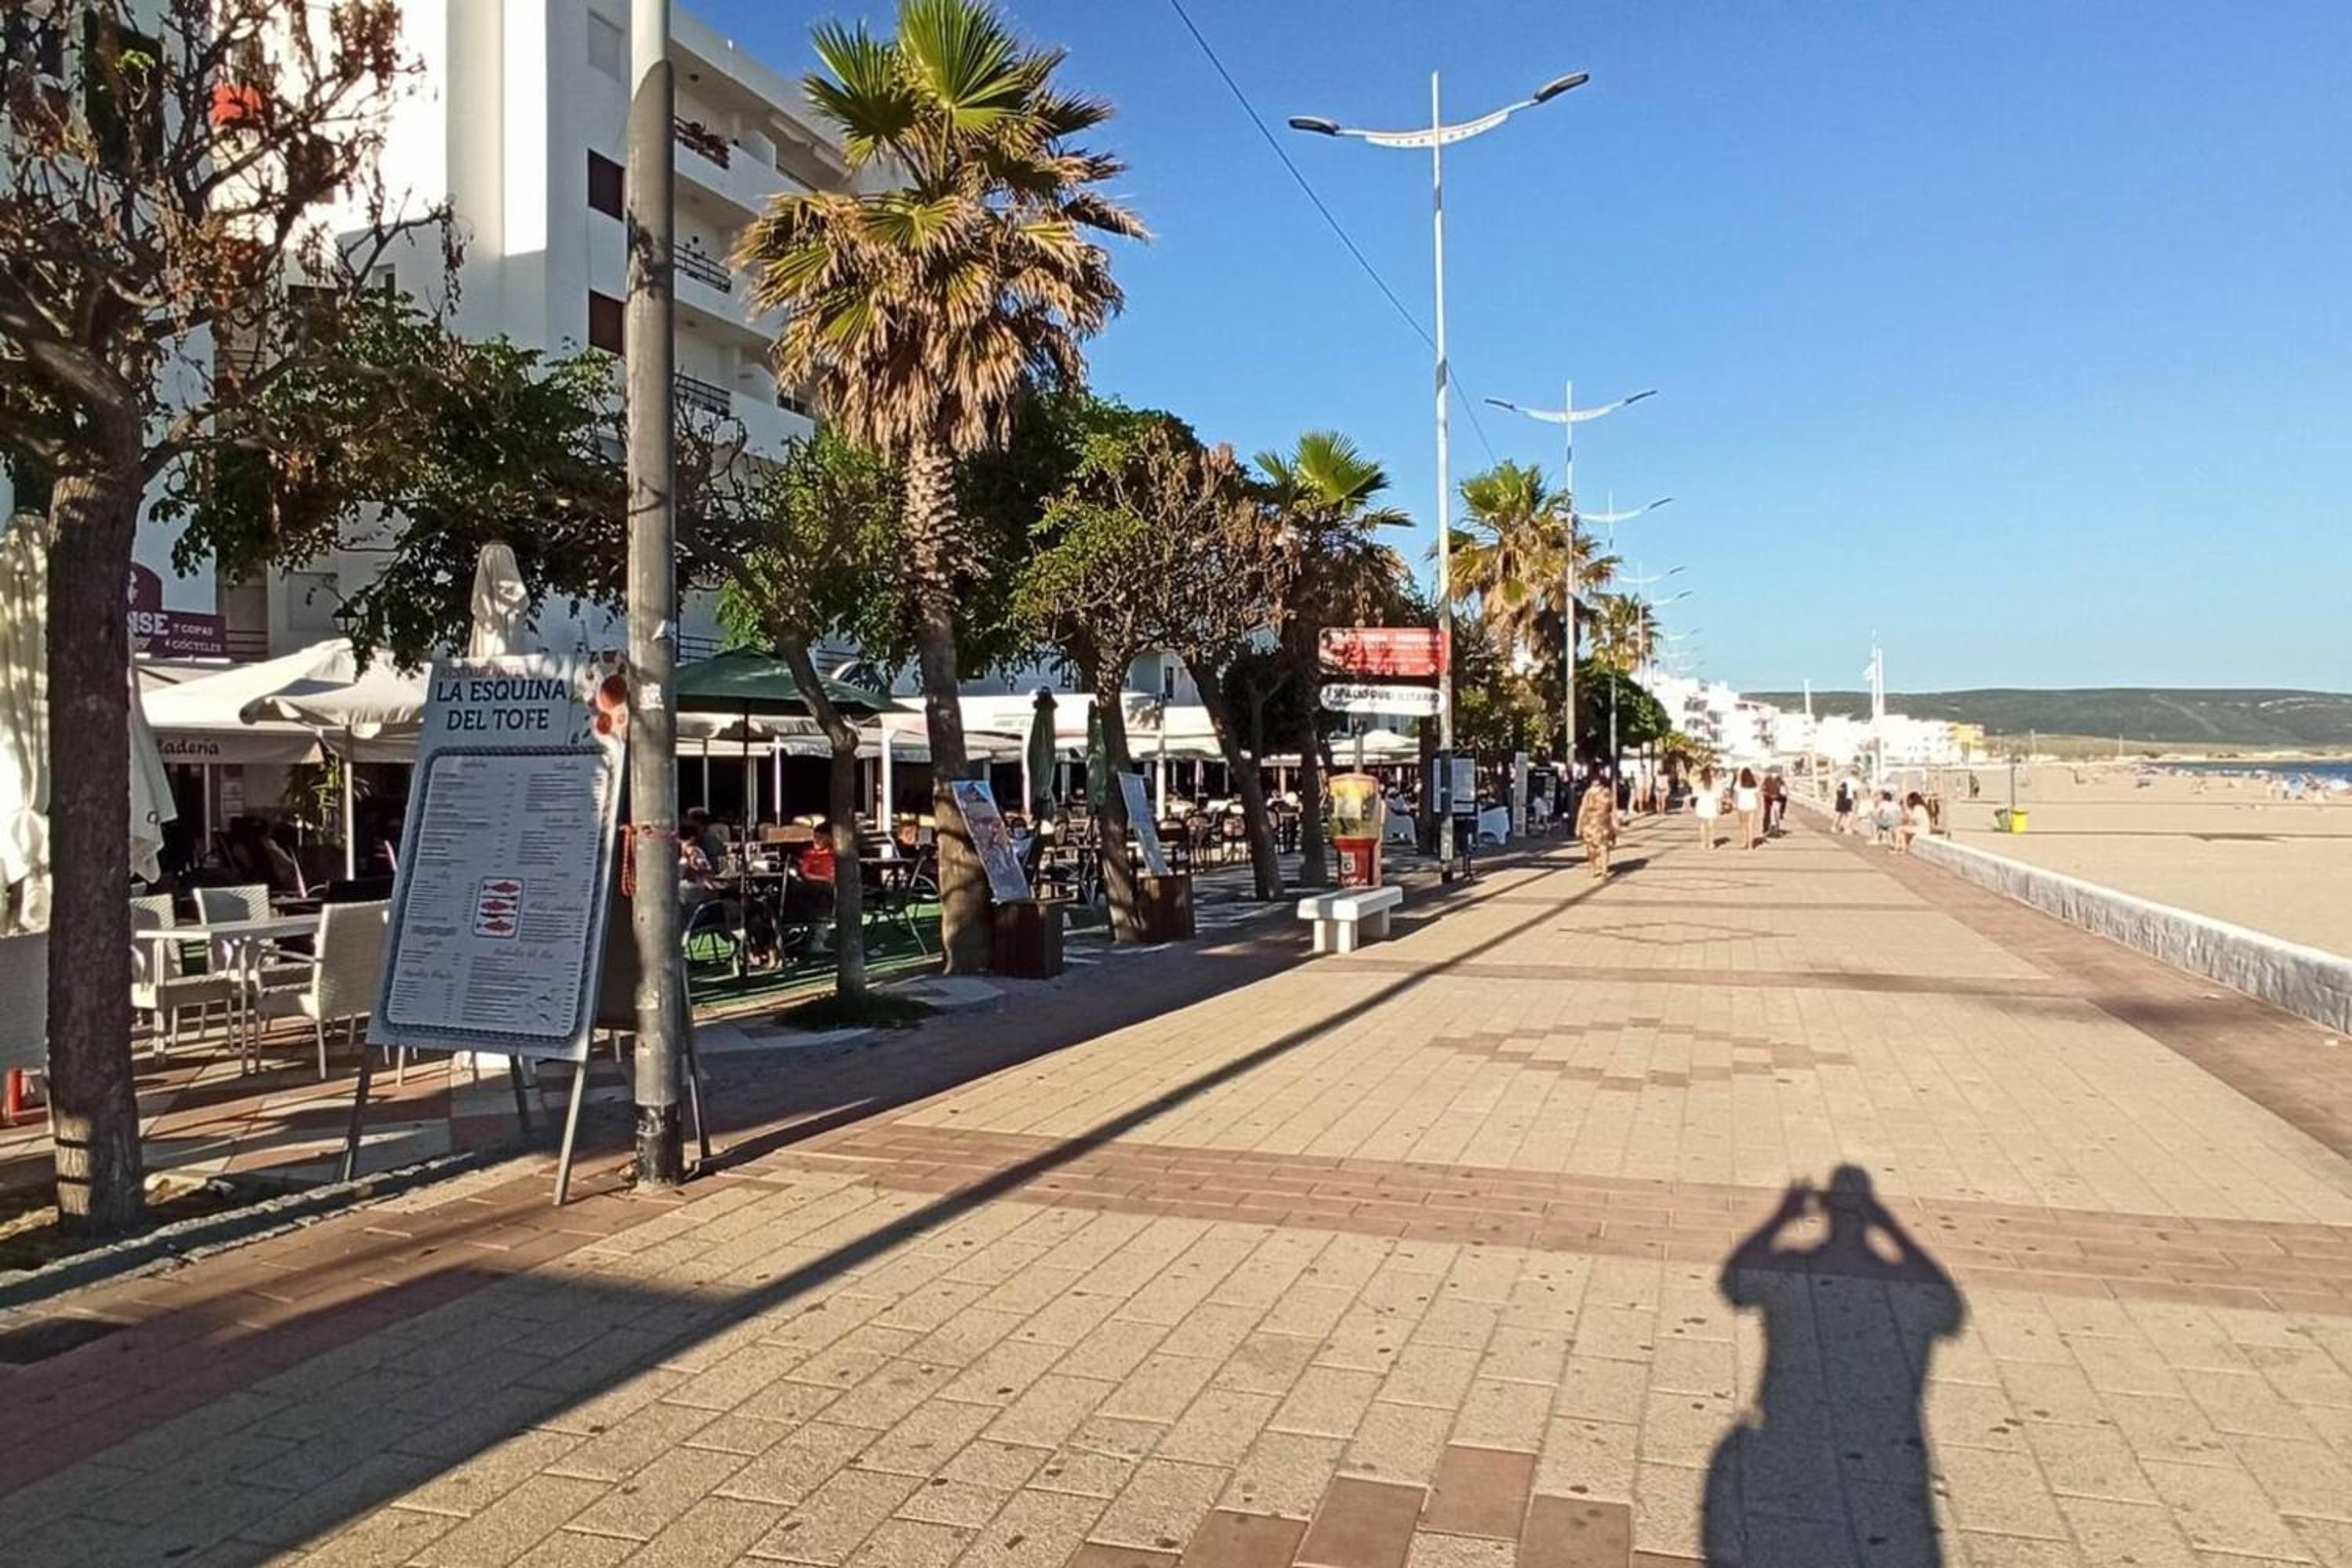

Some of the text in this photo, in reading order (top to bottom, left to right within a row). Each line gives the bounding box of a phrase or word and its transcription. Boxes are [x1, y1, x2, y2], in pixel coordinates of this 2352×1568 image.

[181, 624, 213, 636] COPAS
[437, 679, 567, 702] LA ESQUINA
[447, 709, 550, 731] DEL TOFE
